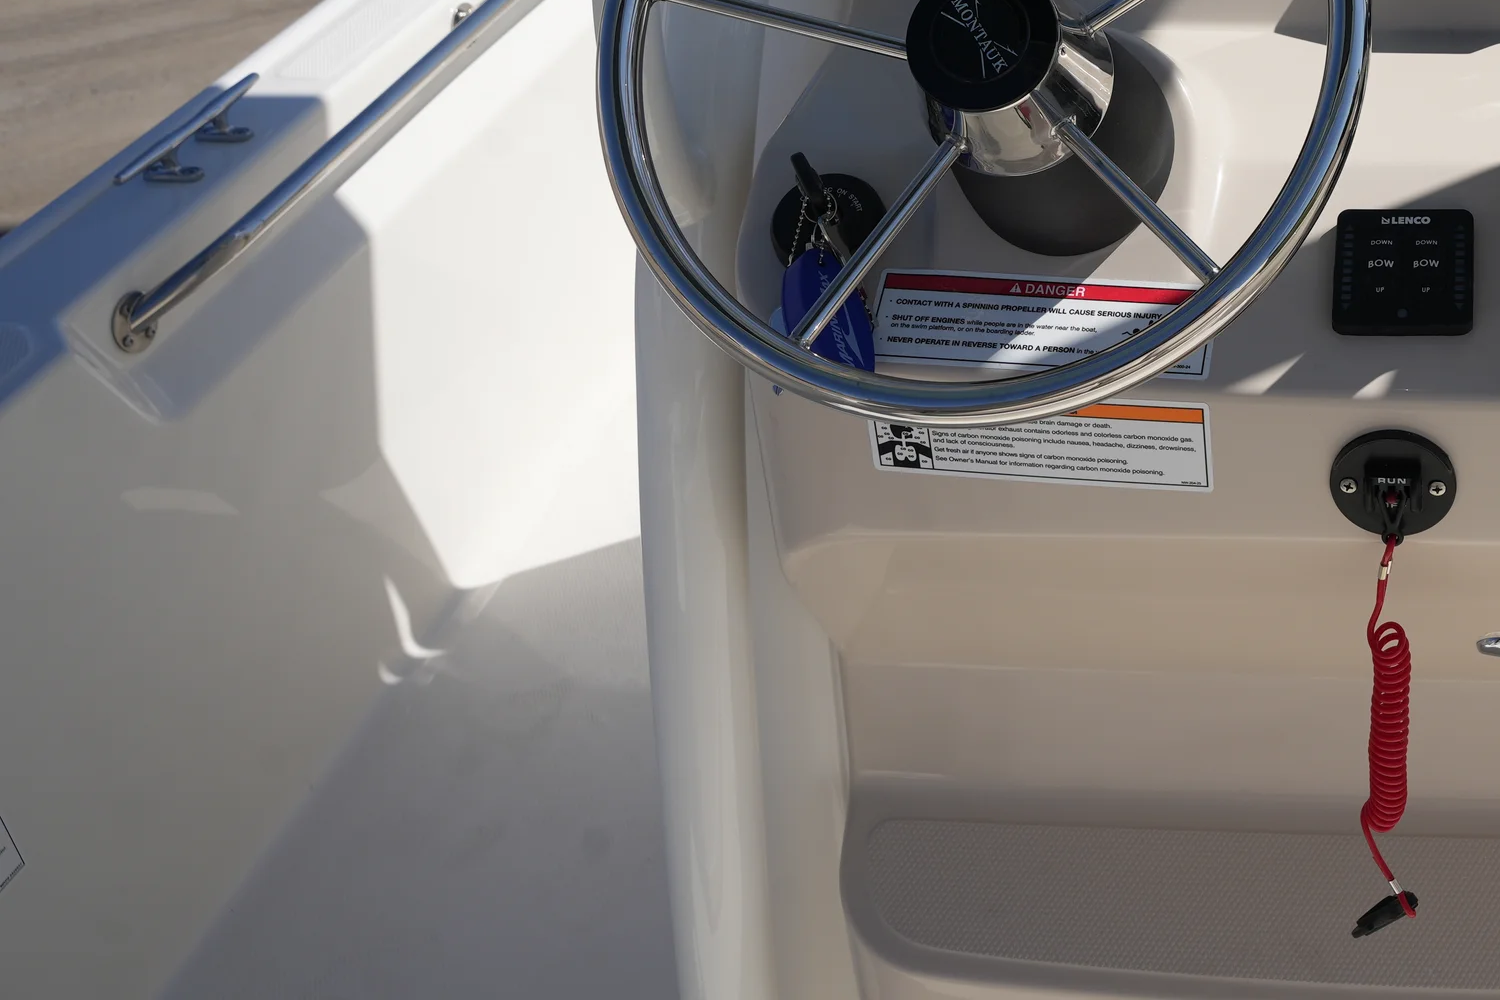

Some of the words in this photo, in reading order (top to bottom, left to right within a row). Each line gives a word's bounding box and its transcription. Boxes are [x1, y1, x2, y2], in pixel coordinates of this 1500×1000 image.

[836, 188, 847, 196] ON
[849, 193, 863, 212] START
[1391, 216, 1431, 225] LENCO
[1368, 259, 1394, 268] BOW
[1413, 259, 1440, 268] BOW
[1025, 283, 1086, 297] DANGER
[896, 299, 932, 307] CONTACT
[962, 302, 999, 311] SPINNING
[1001, 305, 1047, 313] PROPELLER
[1097, 310, 1132, 318] SERIOUS
[1133, 312, 1162, 320] INJURY
[929, 324, 956, 332] platform,
[986, 328, 1013, 336] boarding
[914, 338, 950, 346] OPERATE
[961, 341, 997, 349] REVERSE
[999, 343, 1033, 351] TOWARD
[1011, 436, 1041, 444] poisoning
[949, 456, 974, 464] Owner's
[1132, 468, 1165, 476] poisoning.
